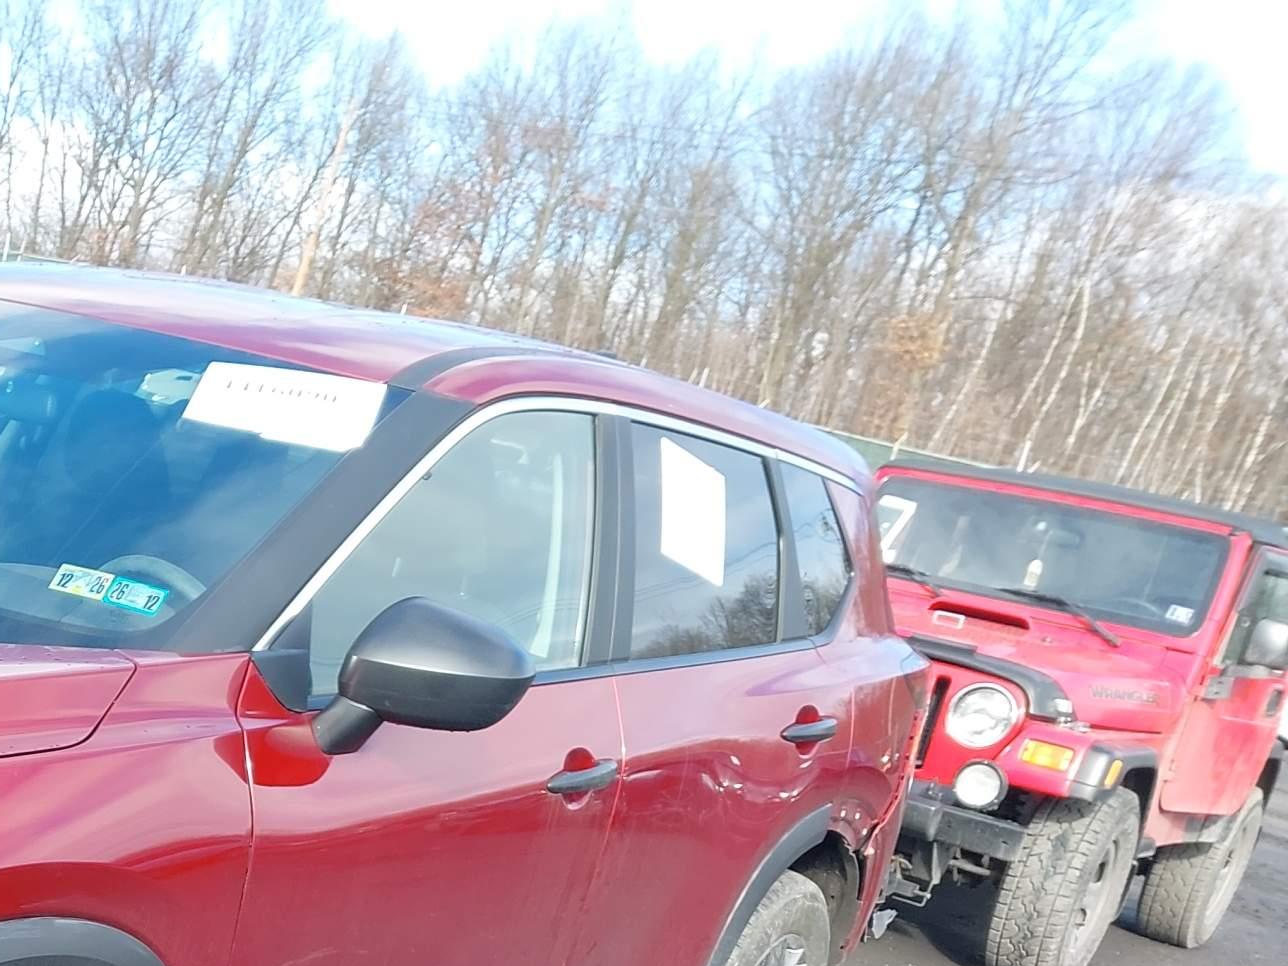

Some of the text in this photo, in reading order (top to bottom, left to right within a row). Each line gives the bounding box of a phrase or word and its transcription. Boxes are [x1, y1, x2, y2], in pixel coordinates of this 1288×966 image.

[56, 573, 106, 595] 12 26
[110, 582, 161, 611] 26 12
